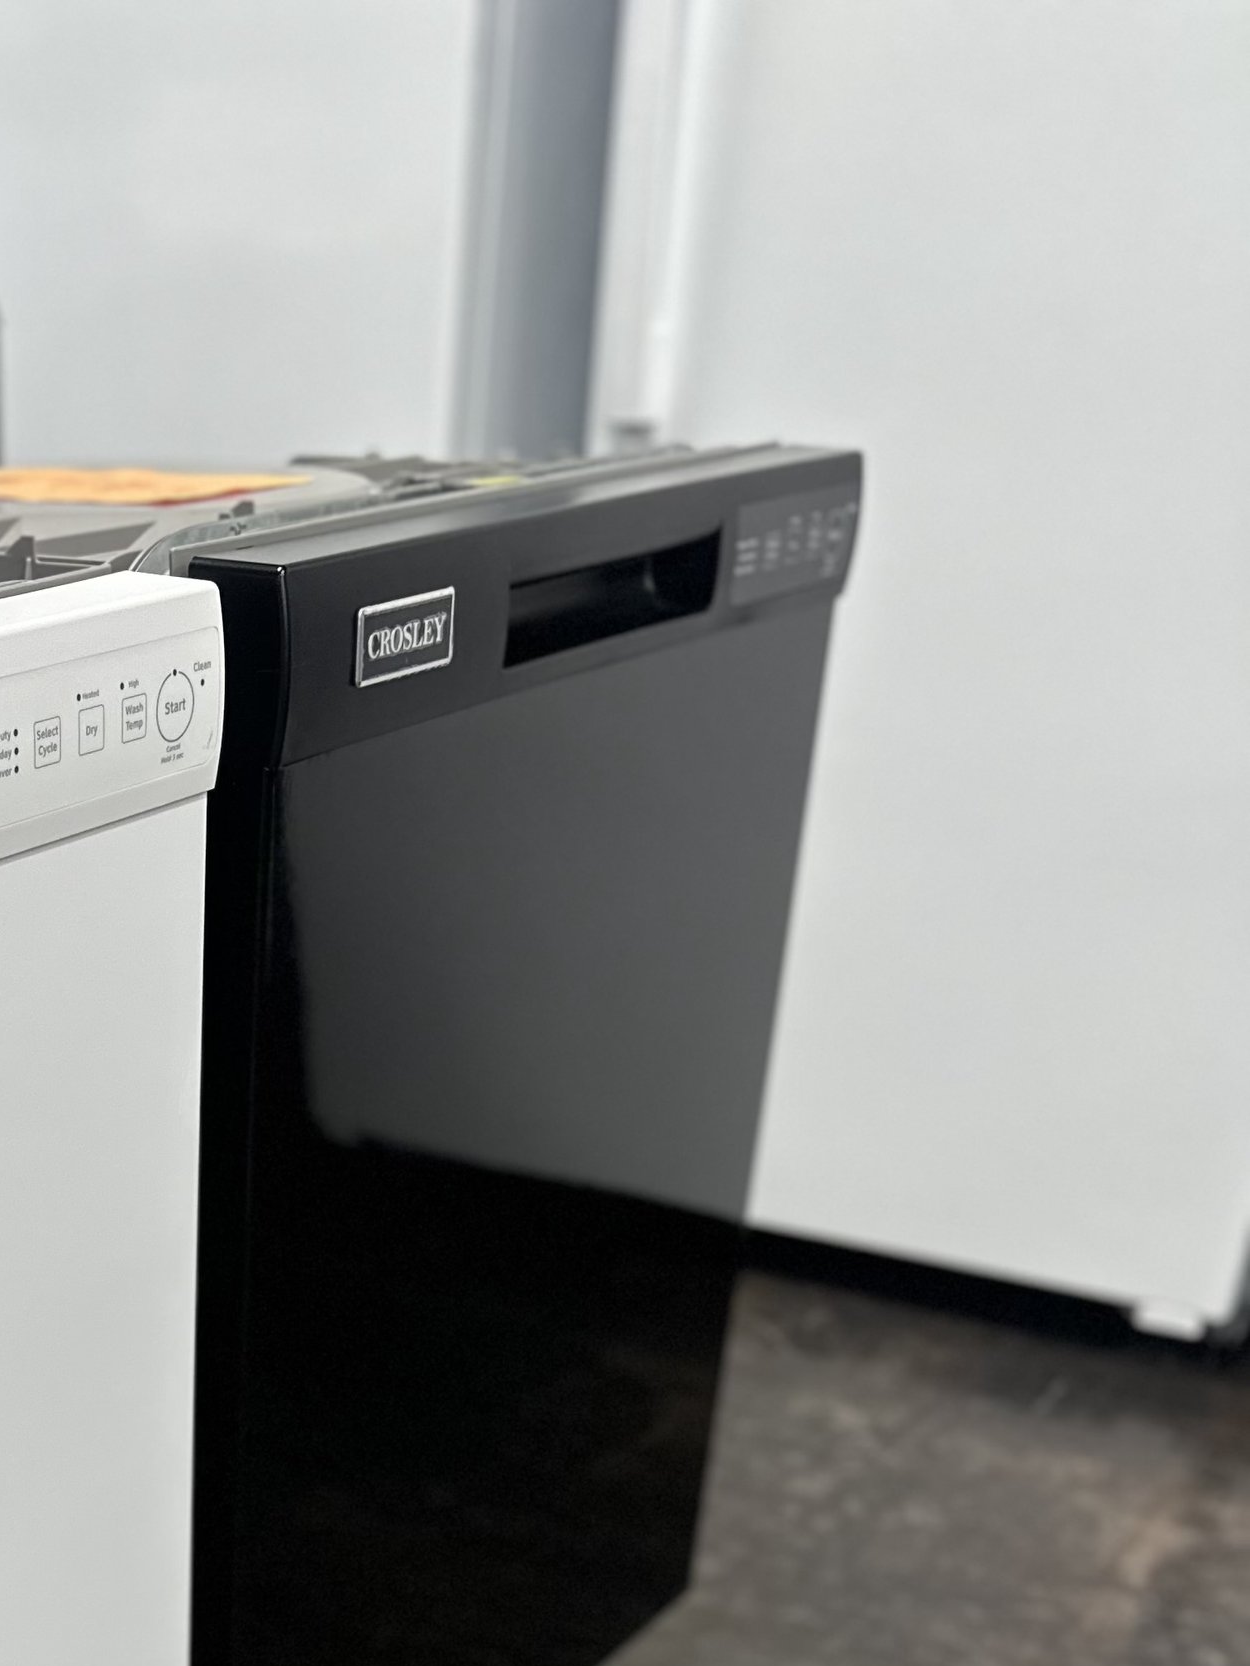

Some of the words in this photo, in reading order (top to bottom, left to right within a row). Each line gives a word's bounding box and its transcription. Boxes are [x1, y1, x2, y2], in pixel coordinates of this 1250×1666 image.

[367, 612, 447, 659] CROSLEY
[193, 660, 212, 672] Clean
[125, 702, 144, 715] Wash
[164, 698, 186, 715] Start
[85, 725, 98, 737] Dry
[126, 720, 144, 731] Temp
[36, 726, 59, 740] Select
[38, 742, 58, 757] Cycle
